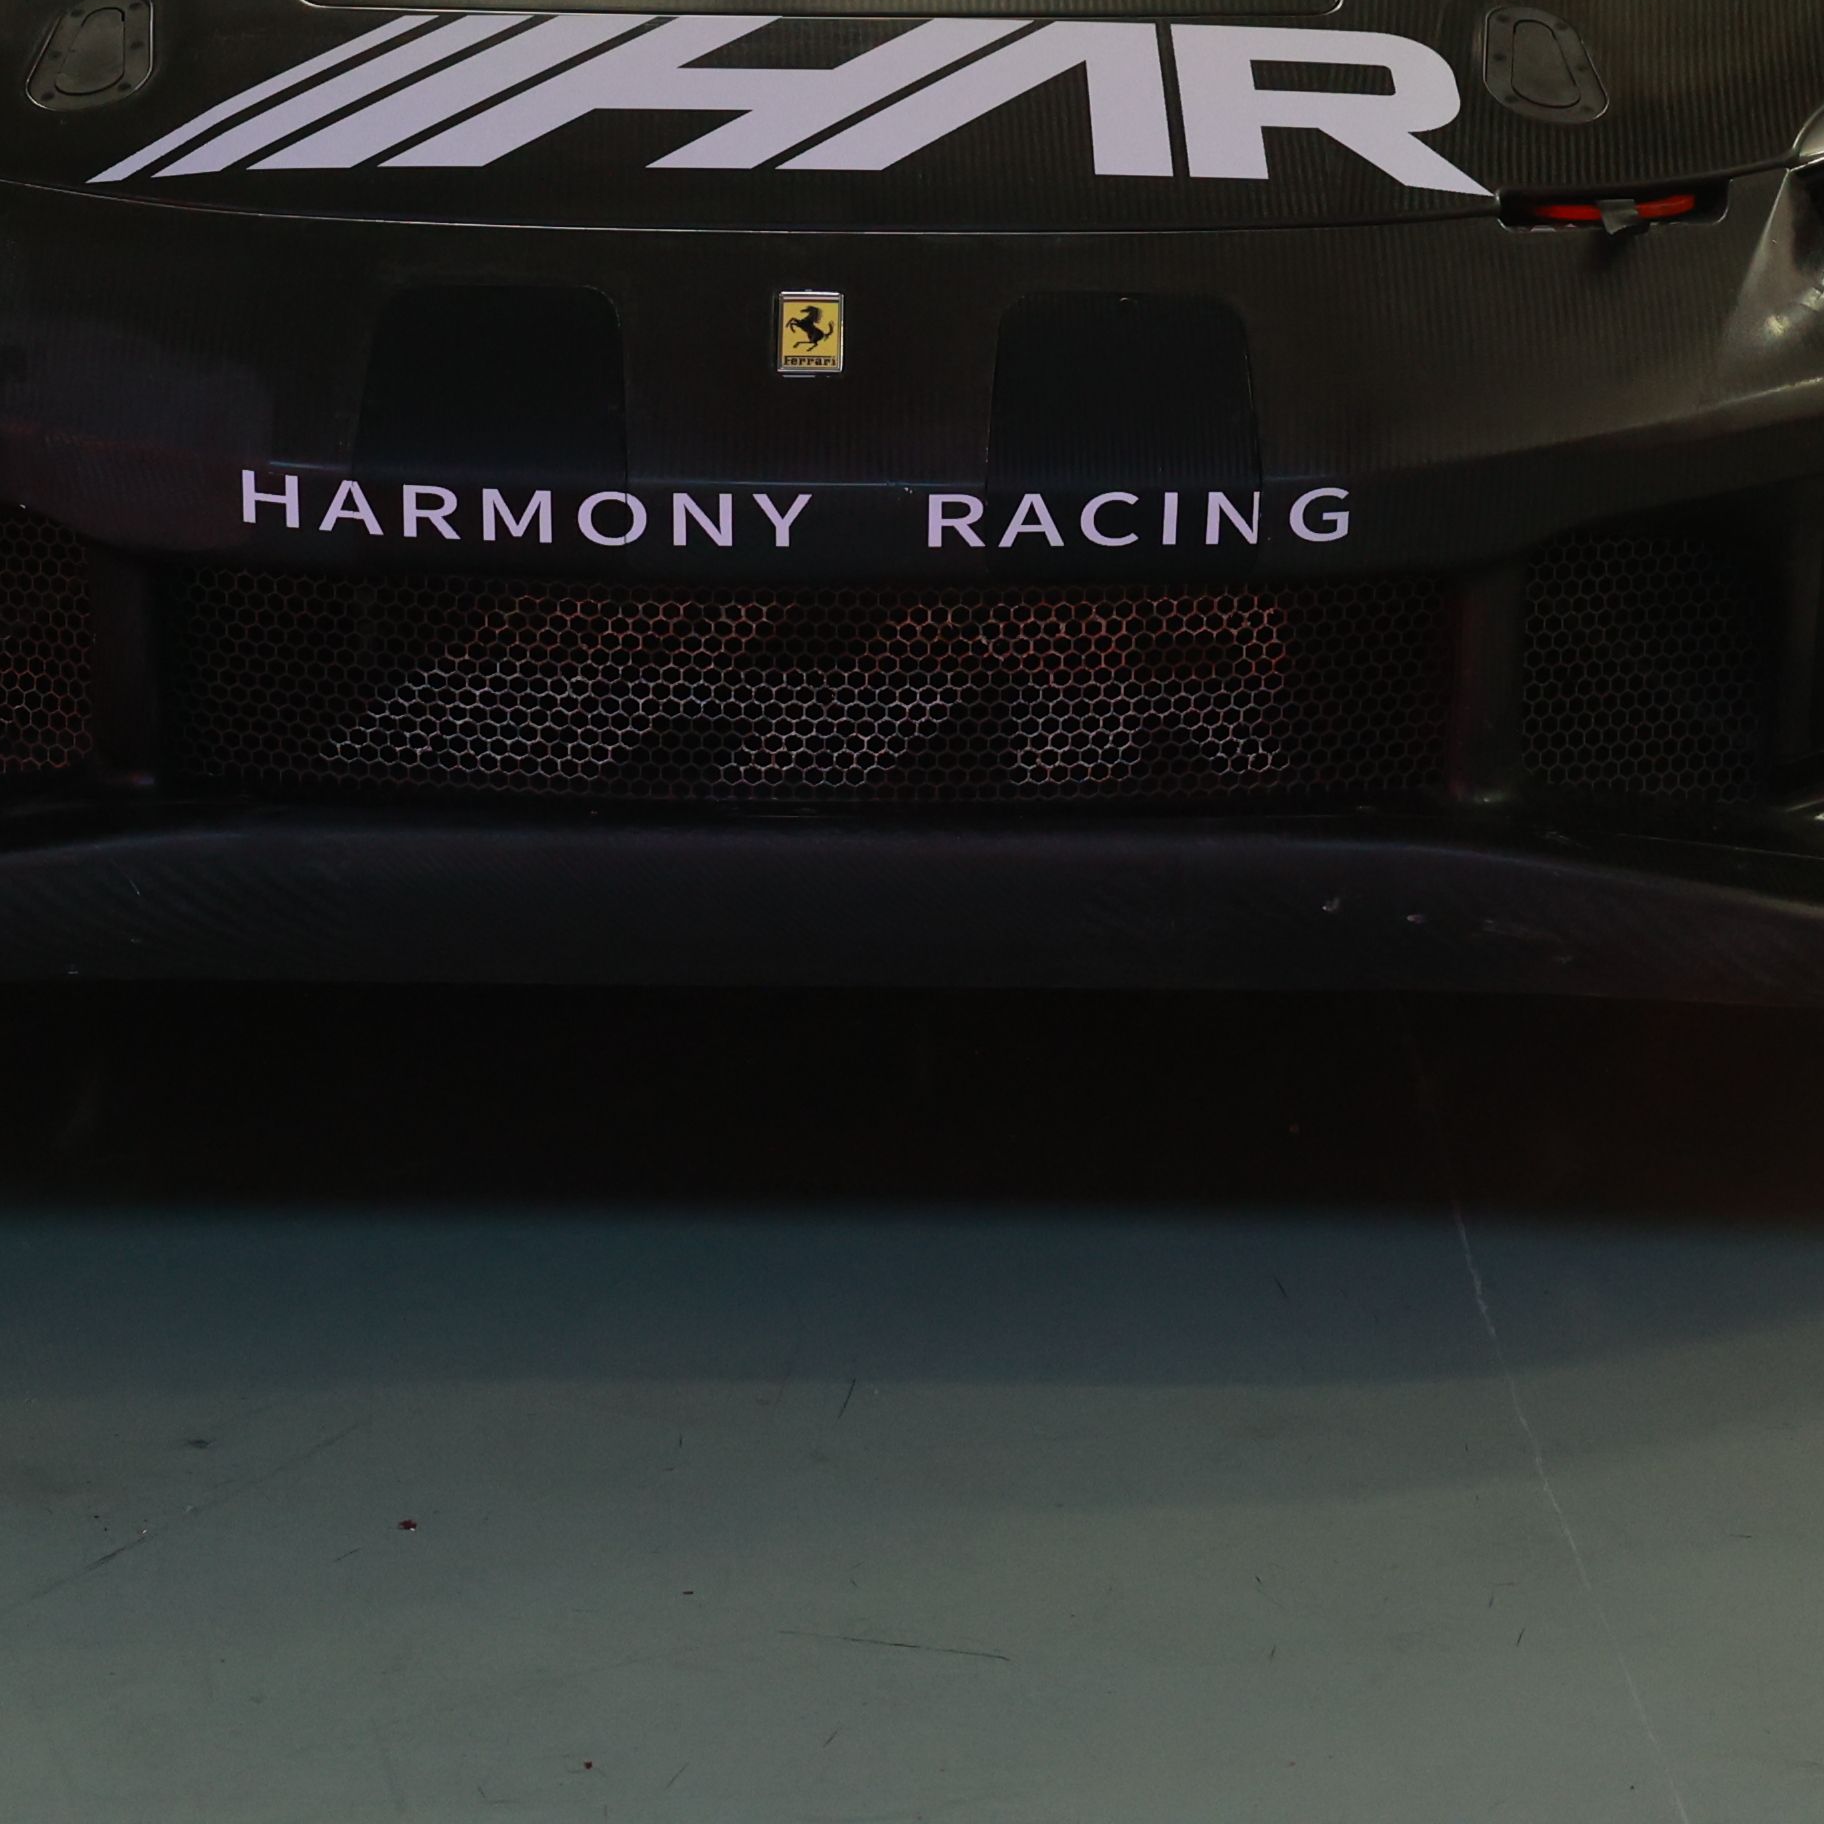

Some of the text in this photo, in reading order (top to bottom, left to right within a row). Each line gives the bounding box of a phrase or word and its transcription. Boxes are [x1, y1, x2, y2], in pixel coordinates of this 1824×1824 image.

[783, 355, 837, 366] Ferrari
[240, 469, 1352, 549] HARMONY RACING
